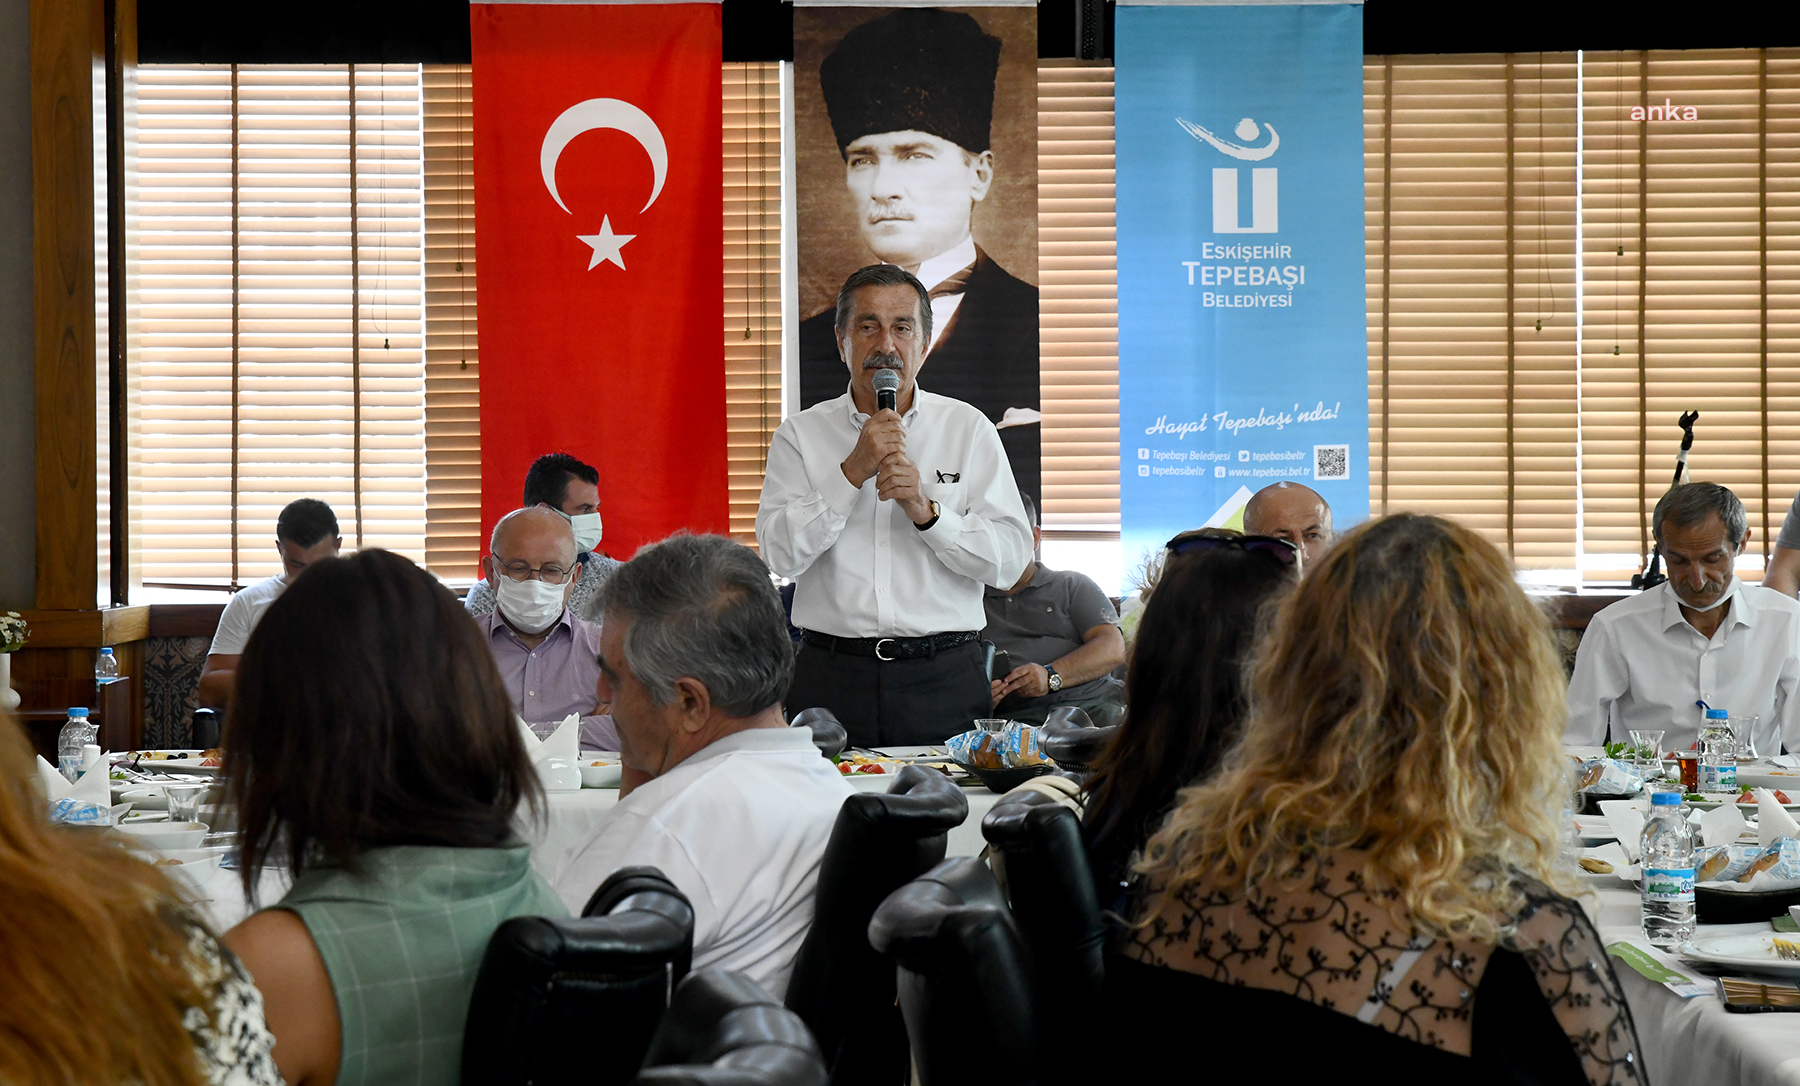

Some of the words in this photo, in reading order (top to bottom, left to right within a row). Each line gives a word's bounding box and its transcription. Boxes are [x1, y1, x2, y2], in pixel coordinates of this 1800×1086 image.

[1202, 241, 1292, 263] ESKİŞEHİR
[1181, 261, 1306, 291] TEPEBAŞI
[1202, 291, 1293, 308] BELEDİYESİ
[1144, 413, 1208, 440] Hayat
[1212, 401, 1341, 436] Tepebaşı'nda!
[1152, 449, 1188, 462] Tepebaşı
[1189, 450, 1231, 463] Belediyesi
[1252, 450, 1306, 463] tepebasibeltr
[1152, 465, 1206, 477] tepebasibeltr
[1228, 466, 1311, 479] www.tepebasi.bel.tr
